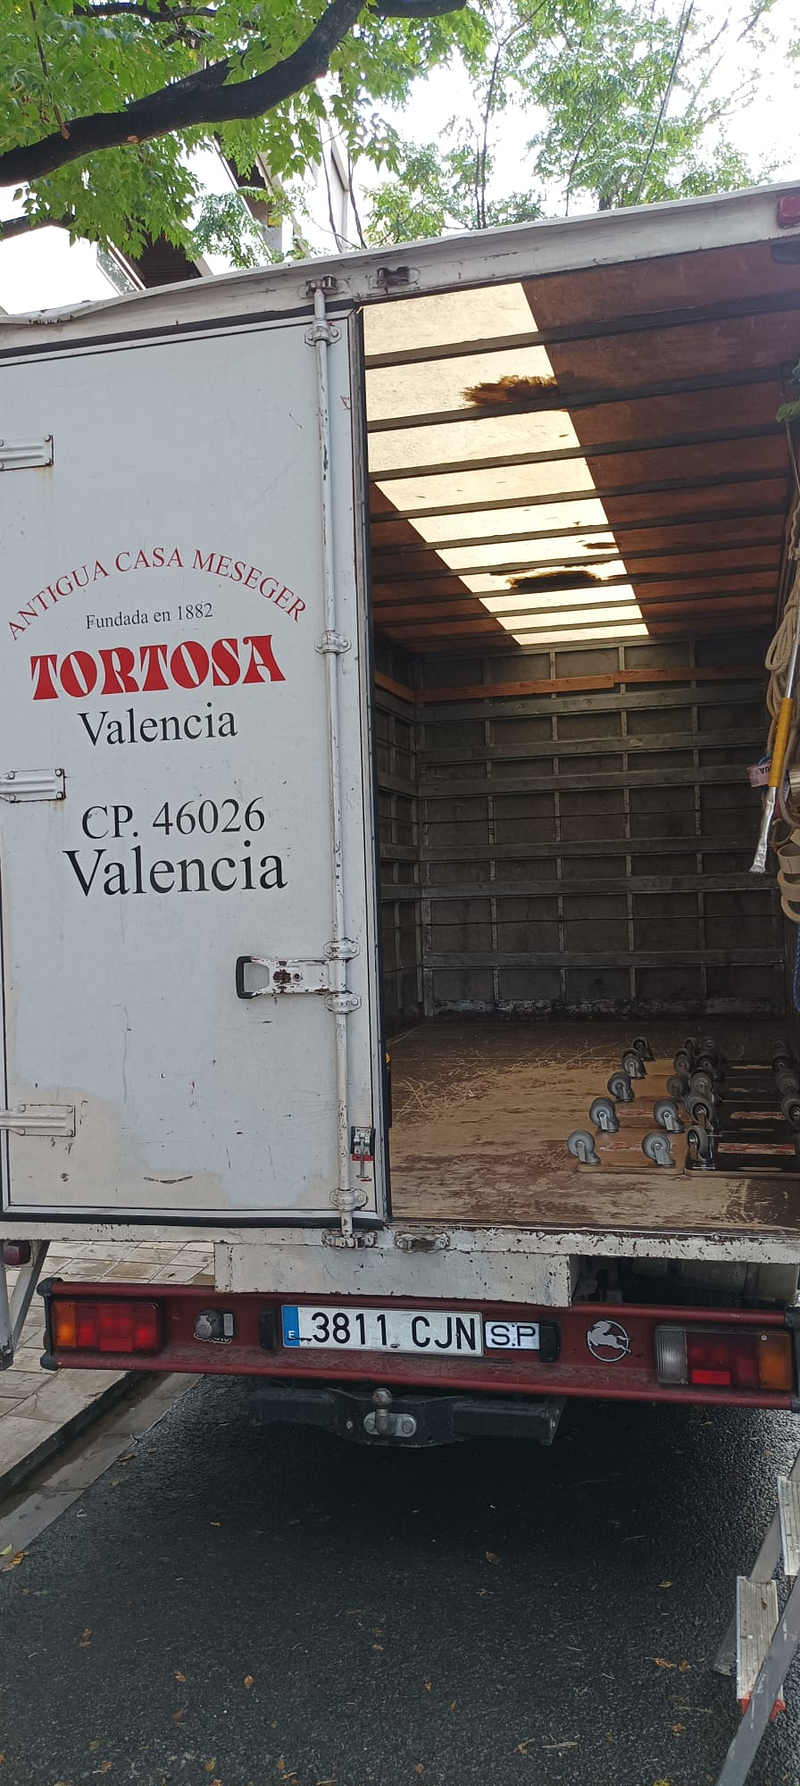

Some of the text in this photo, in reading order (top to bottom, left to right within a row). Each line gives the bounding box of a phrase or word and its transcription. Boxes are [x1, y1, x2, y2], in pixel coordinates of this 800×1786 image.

[7, 547, 307, 641] ANTIGUA CASA MESEGER
[85, 602, 213, 630] Fundada en 1882
[30, 634, 286, 700] TORTOSA
[77, 701, 239, 746] Valencia
[81, 796, 265, 839] CP. 46026
[62, 839, 288, 897] Valencia
[311, 1311, 477, 1351] 3811 CJN
